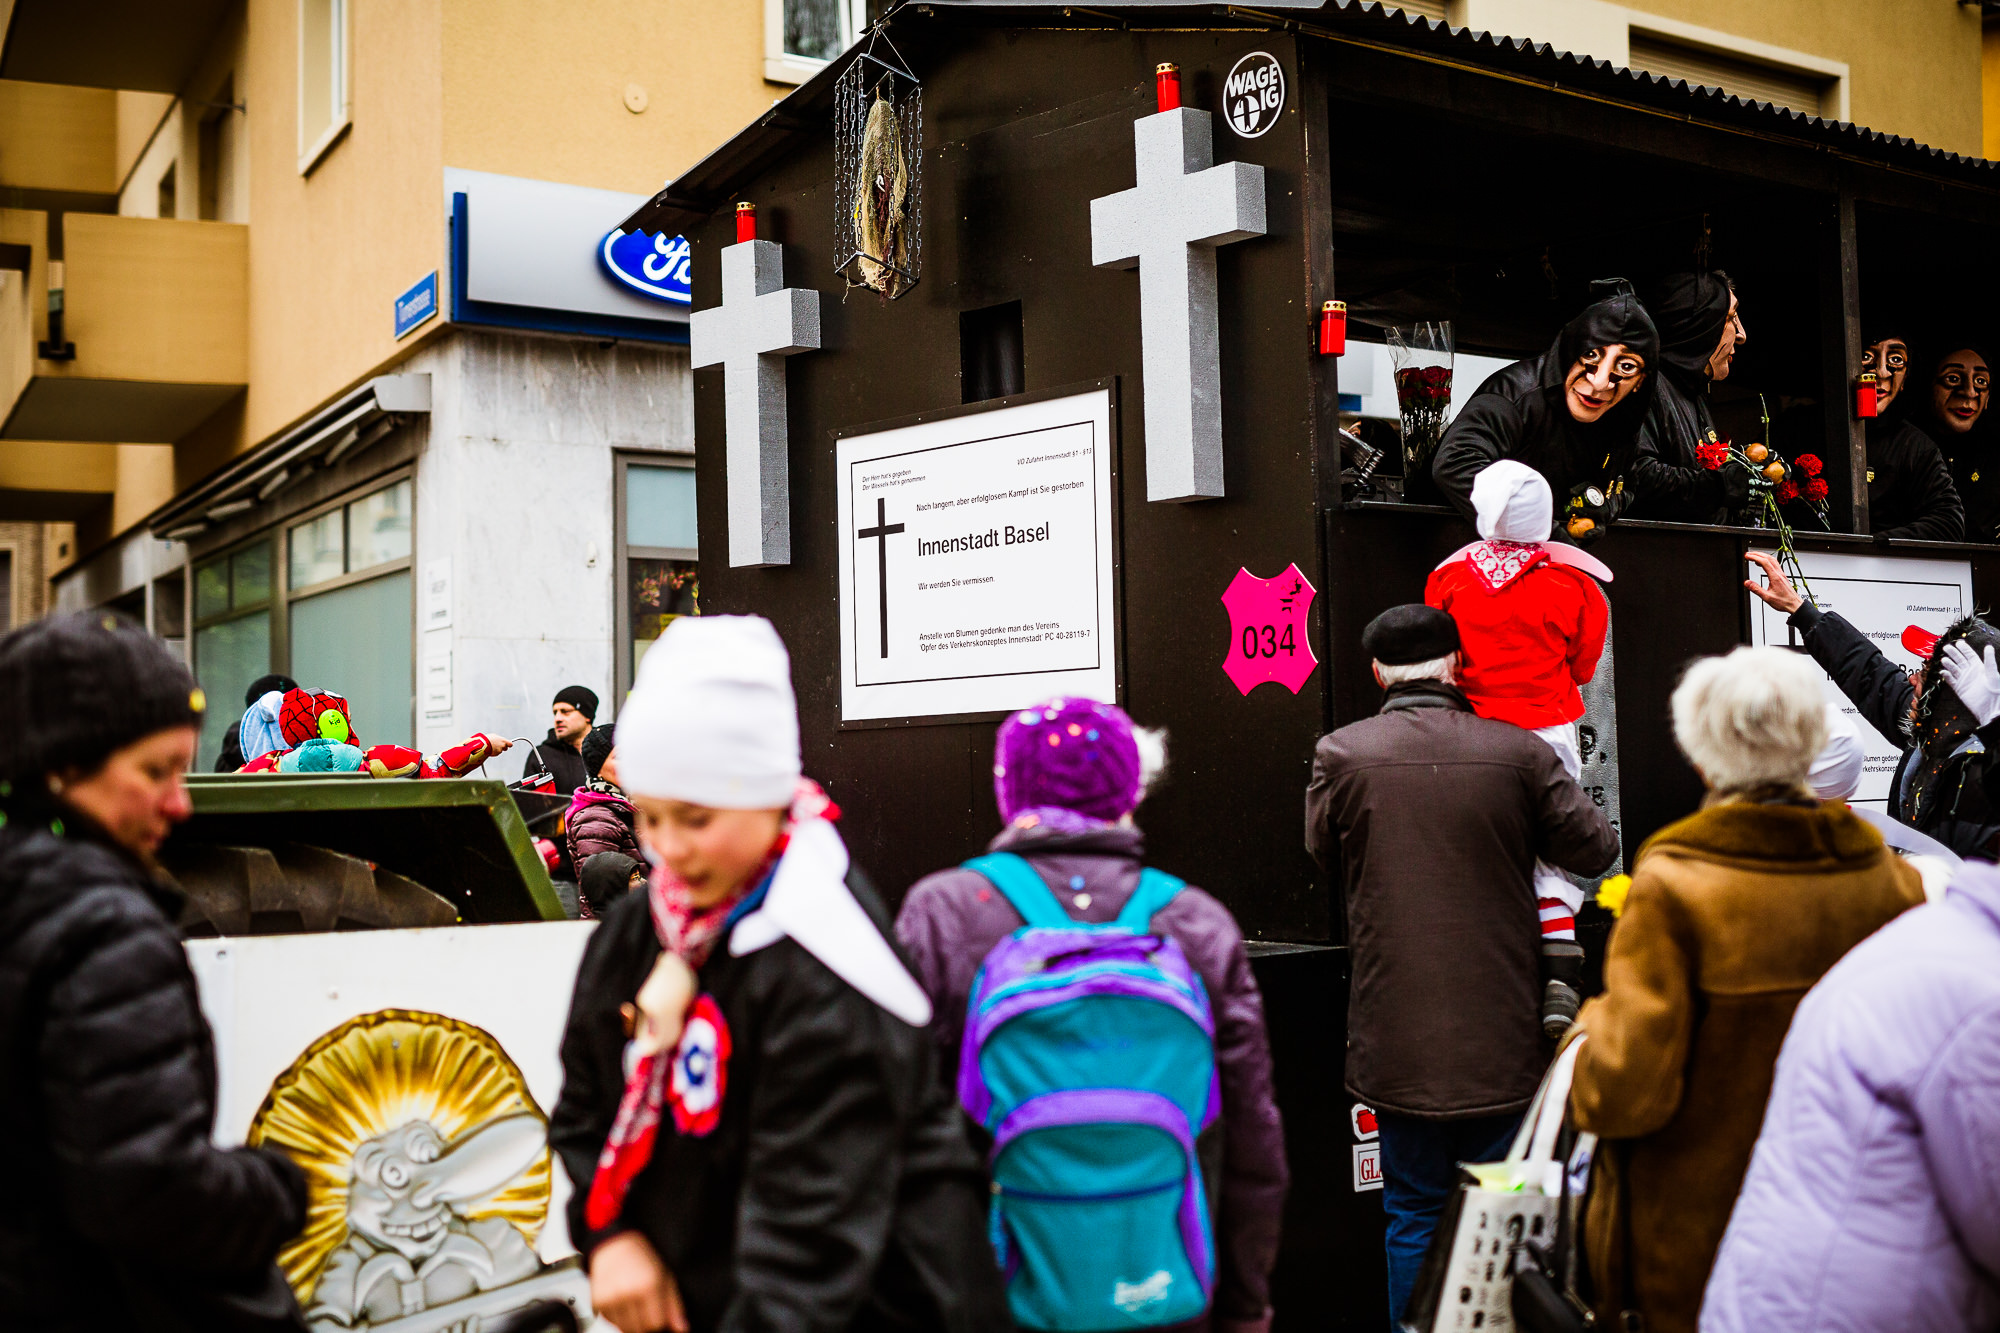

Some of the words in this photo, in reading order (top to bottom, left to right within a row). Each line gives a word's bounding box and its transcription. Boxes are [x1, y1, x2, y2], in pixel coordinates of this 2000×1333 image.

[1228, 63, 1278, 98] WAGE
[1026, 456, 1044, 464] Zufahrt
[1045, 451, 1071, 461] Innenstadt
[892, 469, 912, 480] gegeben
[901, 475, 926, 486] genommen
[916, 502, 931, 512] Nach
[932, 500, 956, 511] langem,
[957, 497, 970, 506] aber
[970, 492, 1008, 504] erfolglosem
[1008, 487, 1029, 499] Kampf
[1030, 486, 1038, 495] ist
[1039, 485, 1050, 494] Sie
[1051, 480, 1085, 495] gestorben
[918, 528, 999, 557] Innenstadt
[1004, 521, 1049, 546] Basel
[917, 582, 928, 591] Wir
[929, 580, 951, 590] werden
[951, 578, 962, 587] Sie
[962, 575, 996, 586] vermissen.
[1926, 605, 1946, 613] Innenstadt
[919, 631, 943, 641] Anstelle
[943, 630, 955, 639] von
[955, 629, 979, 638] Blumen
[979, 626, 1007, 638] gedenke
[1007, 625, 1022, 633] man
[1022, 623, 1035, 632] des
[1035, 620, 1060, 630] Vereins
[937, 642, 949, 651] des
[949, 636, 1008, 650] Verkehrskonzeptes
[1044, 631, 1055, 641] PC
[1055, 628, 1091, 640] 40-28119-7
[1871, 630, 1900, 641] erfolglosem
[1242, 623, 1297, 660] 034
